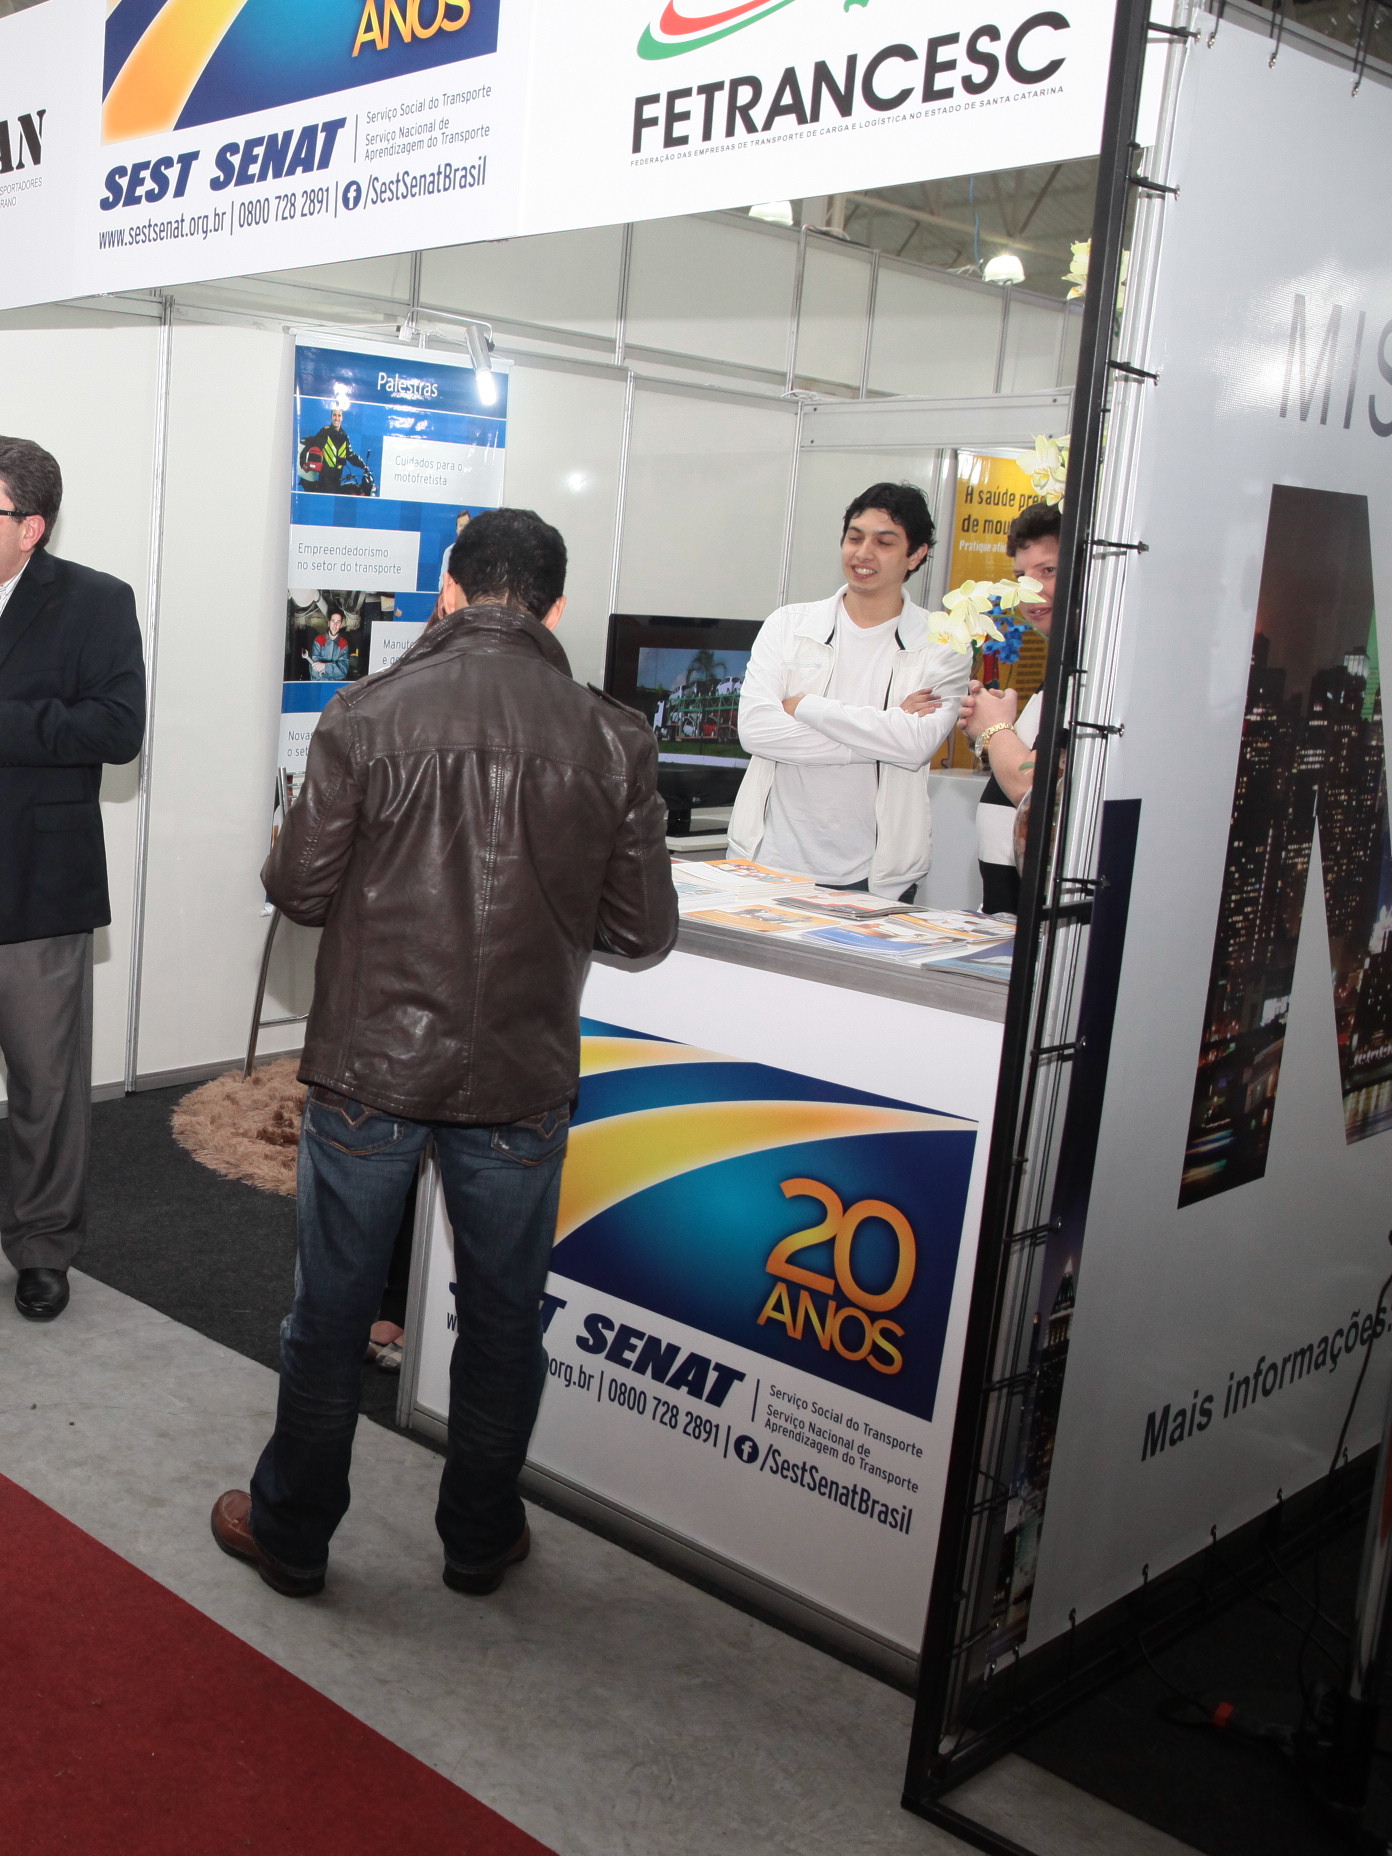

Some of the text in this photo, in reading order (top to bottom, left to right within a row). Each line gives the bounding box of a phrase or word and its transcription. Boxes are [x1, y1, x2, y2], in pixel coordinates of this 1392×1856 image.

[352, 0, 471, 57] ANOS
[367, 84, 492, 124] Serviço Social do Transporte
[632, 11, 1071, 154] FETRANCESC
[365, 117, 450, 146] Serviço Nacional de
[365, 124, 490, 162] Aprendizagem do Transporte
[630, 152, 675, 167] FEDERAÇÃO
[677, 150, 693, 160] DAS
[694, 143, 736, 157] EMPRESAS
[737, 141, 748, 150] DE
[750, 132, 804, 147] TRANSPORTE
[806, 129, 818, 138] DE
[819, 124, 849, 136] CARGA
[859, 114, 907, 129] LOGÍSTICA
[909, 111, 922, 120] NO
[924, 104, 962, 118] ESTADO
[964, 102, 976, 111] DE
[979, 95, 1011, 108] SANTA
[1013, 86, 1064, 102] CATARINA
[100, 117, 347, 212] SEST SENAT
[98, 207, 228, 251] www.sestsenat.org.br
[238, 197, 270, 228] 0800
[274, 193, 297, 222] 728
[300, 186, 330, 218] 2891
[363, 155, 487, 210] /SestSenatBrasil
[377, 371, 438, 397] Palestras
[394, 473, 448, 487] motofretista
[395, 455, 463, 473] Cuidados para o
[962, 514, 979, 533] de
[965, 485, 974, 504] A
[978, 486, 1016, 507] saúde
[297, 561, 402, 575] no setor do transporte
[298, 543, 389, 558] Empreendedorismo
[765, 1177, 916, 1313] 20
[756, 1281, 906, 1375] ANOS
[575, 1313, 747, 1408] SENAT
[766, 1404, 871, 1458] Serviço Nacional de
[769, 1384, 923, 1459] Serviço Social do Transporte
[1141, 1389, 1214, 1462] Mais
[608, 1378, 647, 1416] 0800
[651, 1396, 679, 1430] 728
[682, 1411, 720, 1448] 2891
[759, 1443, 913, 1535] /SestSenatBrasil
[765, 1417, 919, 1494] Aprendizagem do Transporte
